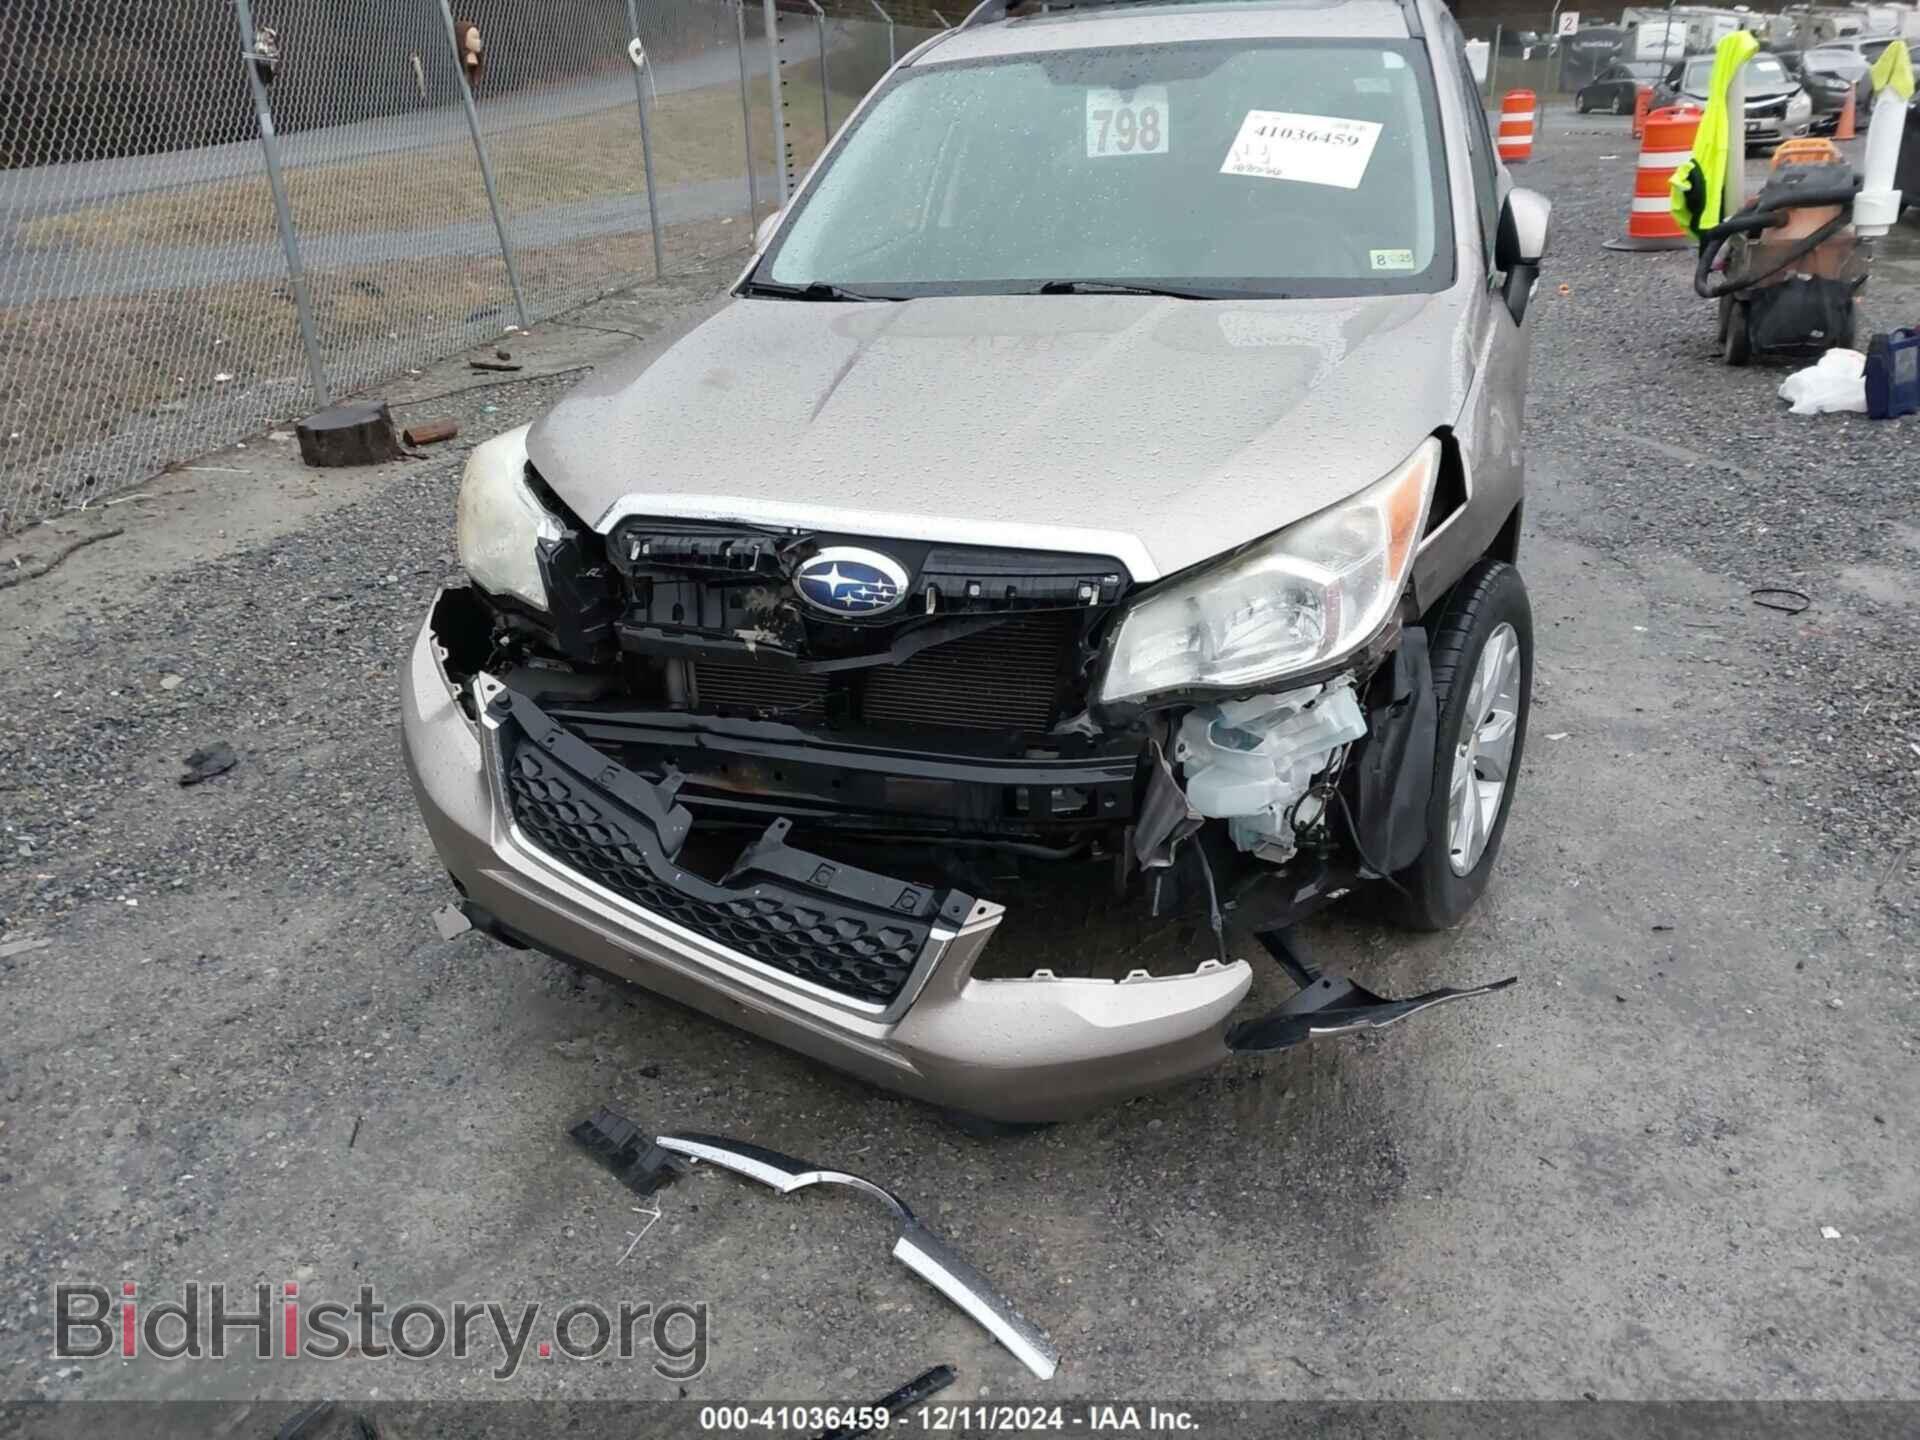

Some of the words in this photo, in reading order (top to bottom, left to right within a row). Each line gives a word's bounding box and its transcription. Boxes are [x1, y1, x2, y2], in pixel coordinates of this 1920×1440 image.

[1564, 16, 1574, 31] 2
[1092, 106, 1161, 153] 798
[1253, 124, 1360, 147] 41036459
[1376, 254, 1387, 266] 8
